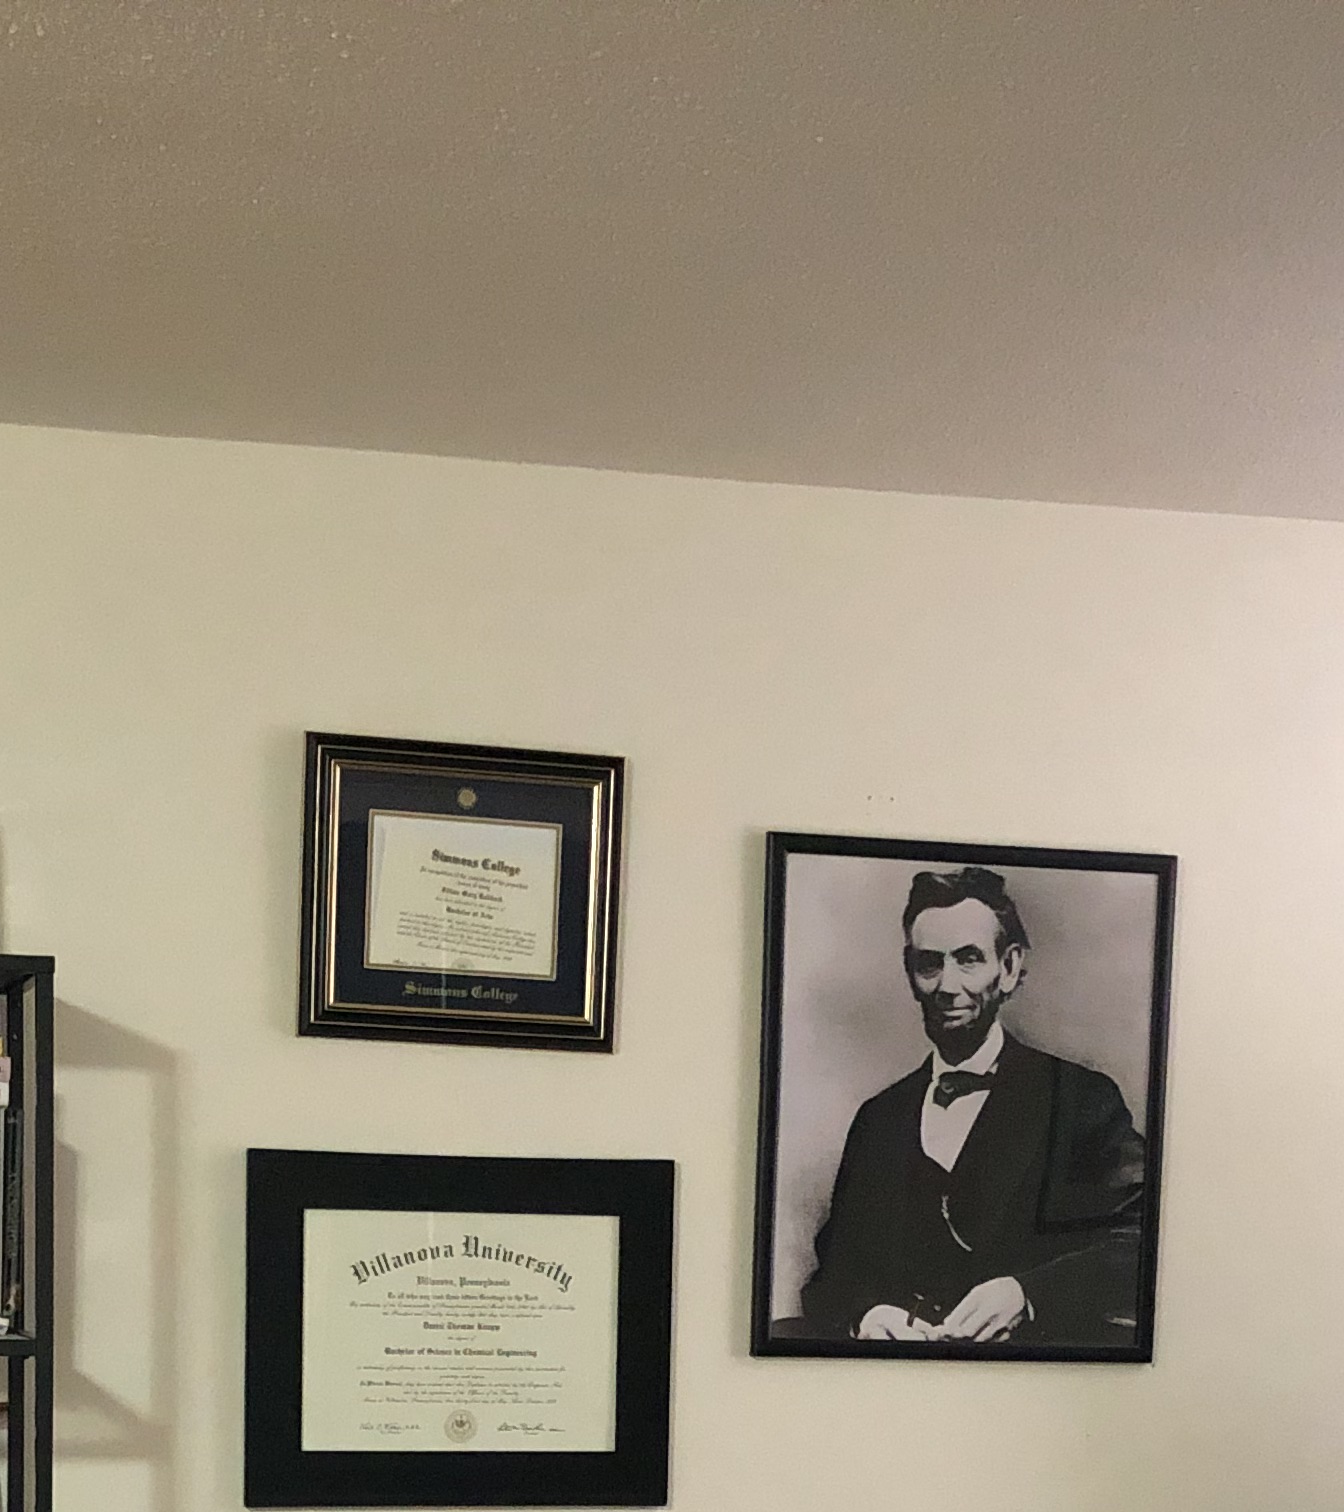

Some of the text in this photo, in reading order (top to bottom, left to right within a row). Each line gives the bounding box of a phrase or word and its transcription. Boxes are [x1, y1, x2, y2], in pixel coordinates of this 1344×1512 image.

[432, 848, 479, 869] Simmons
[481, 857, 521, 878] College
[350, 1234, 574, 1293] Villanova University
